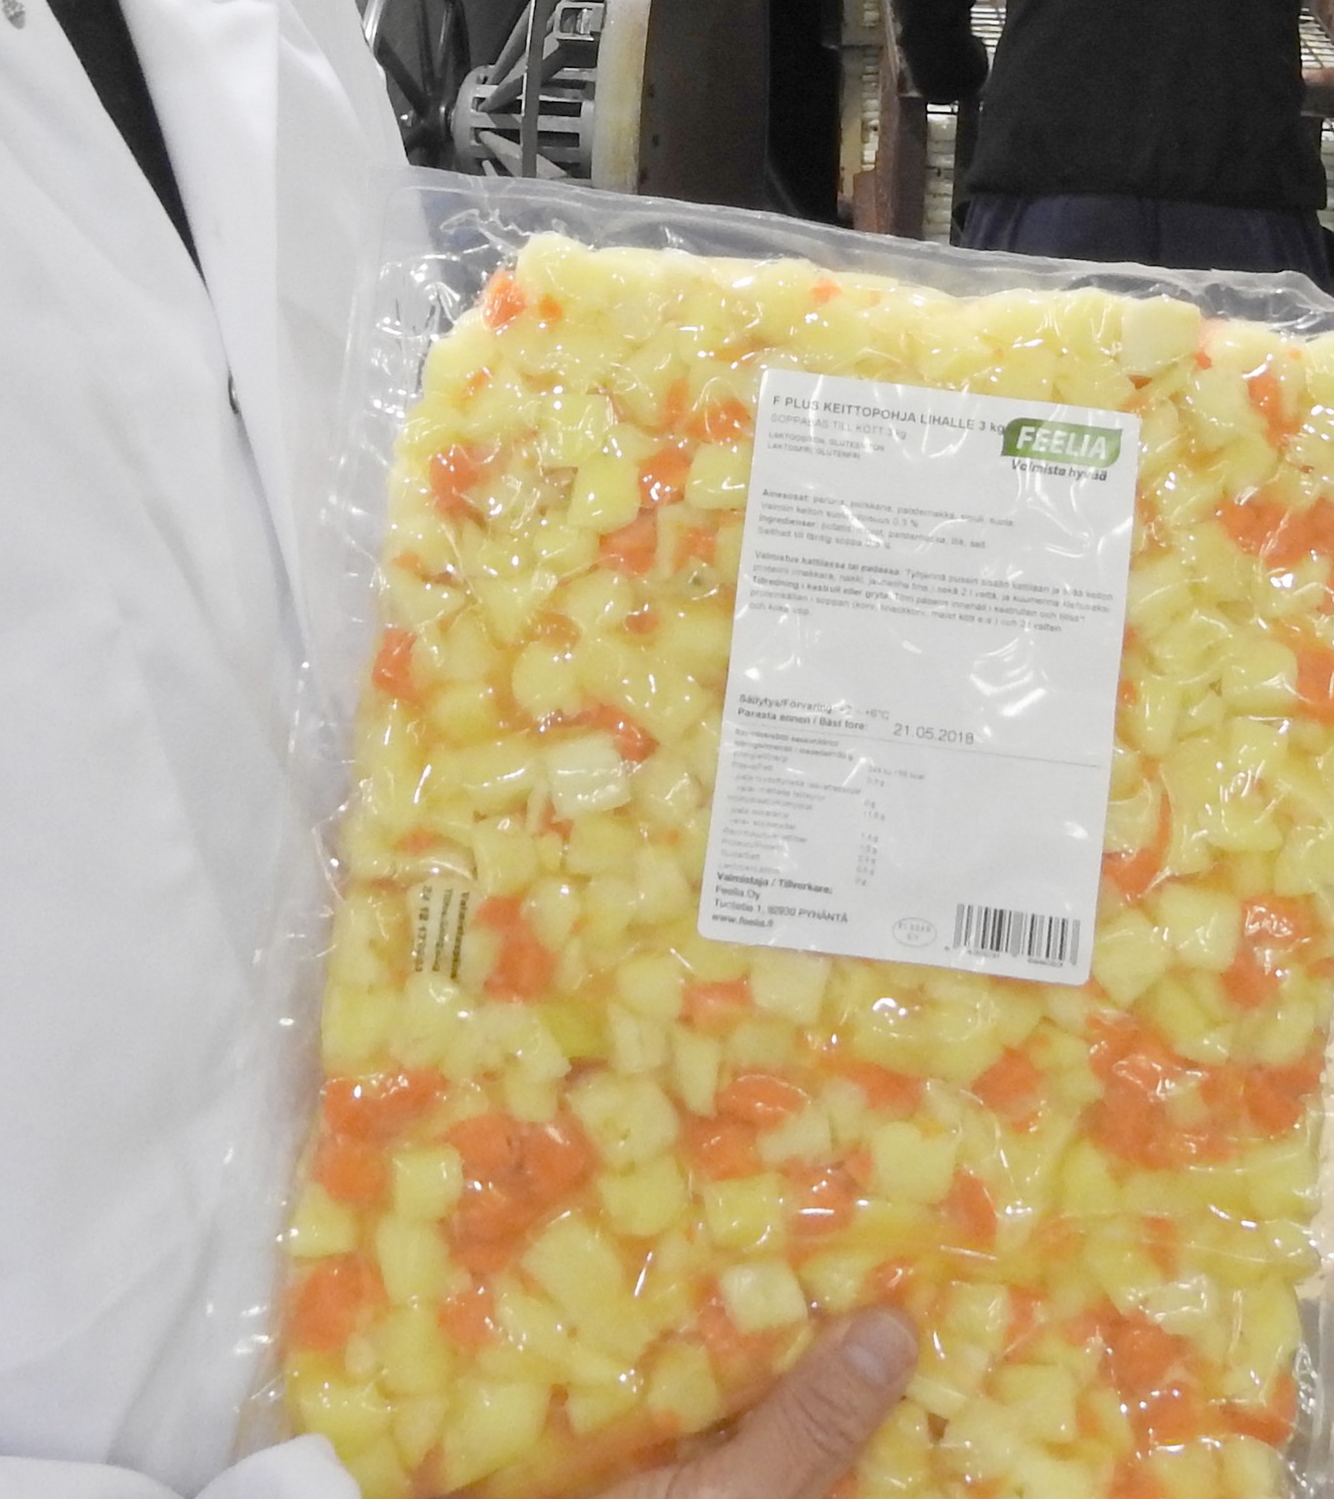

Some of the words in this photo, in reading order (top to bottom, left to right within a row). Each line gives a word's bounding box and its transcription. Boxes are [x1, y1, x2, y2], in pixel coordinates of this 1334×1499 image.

[785, 396, 819, 410] PLUS
[823, 401, 915, 422] KEITTOPOHJA
[920, 413, 973, 429] LIHALLE
[978, 420, 985, 431] 3
[989, 422, 1004, 435] kg
[1016, 425, 1107, 460] FEELIA
[737, 707, 777, 720] Parasta
[779, 712, 810, 724] ennen
[892, 722, 974, 746] 21.05.2018
[798, 907, 848, 923] PYHÄNTÄ
